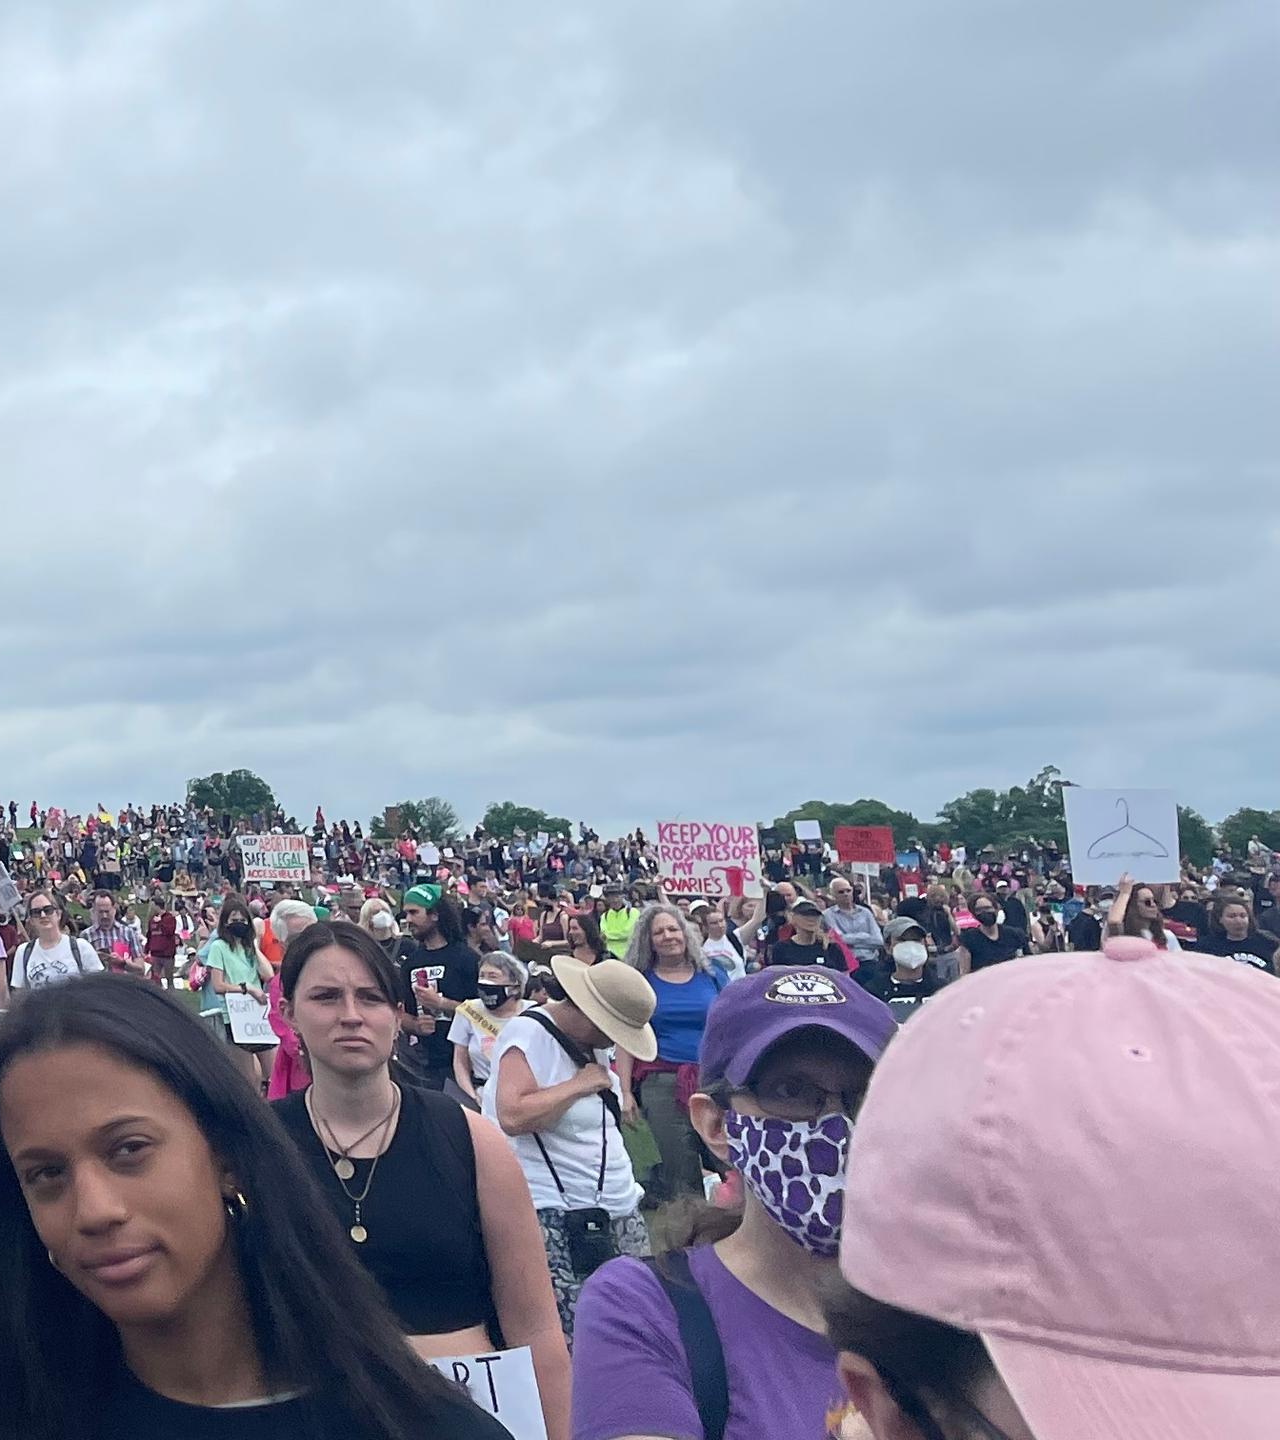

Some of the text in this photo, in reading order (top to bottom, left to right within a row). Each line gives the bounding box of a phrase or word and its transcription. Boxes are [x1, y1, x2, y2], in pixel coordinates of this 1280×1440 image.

[658, 822, 754, 845] KEEP YOUR
[258, 836, 305, 852] ABORTION
[660, 844, 730, 863] ROSARIES
[672, 861, 694, 876] MY
